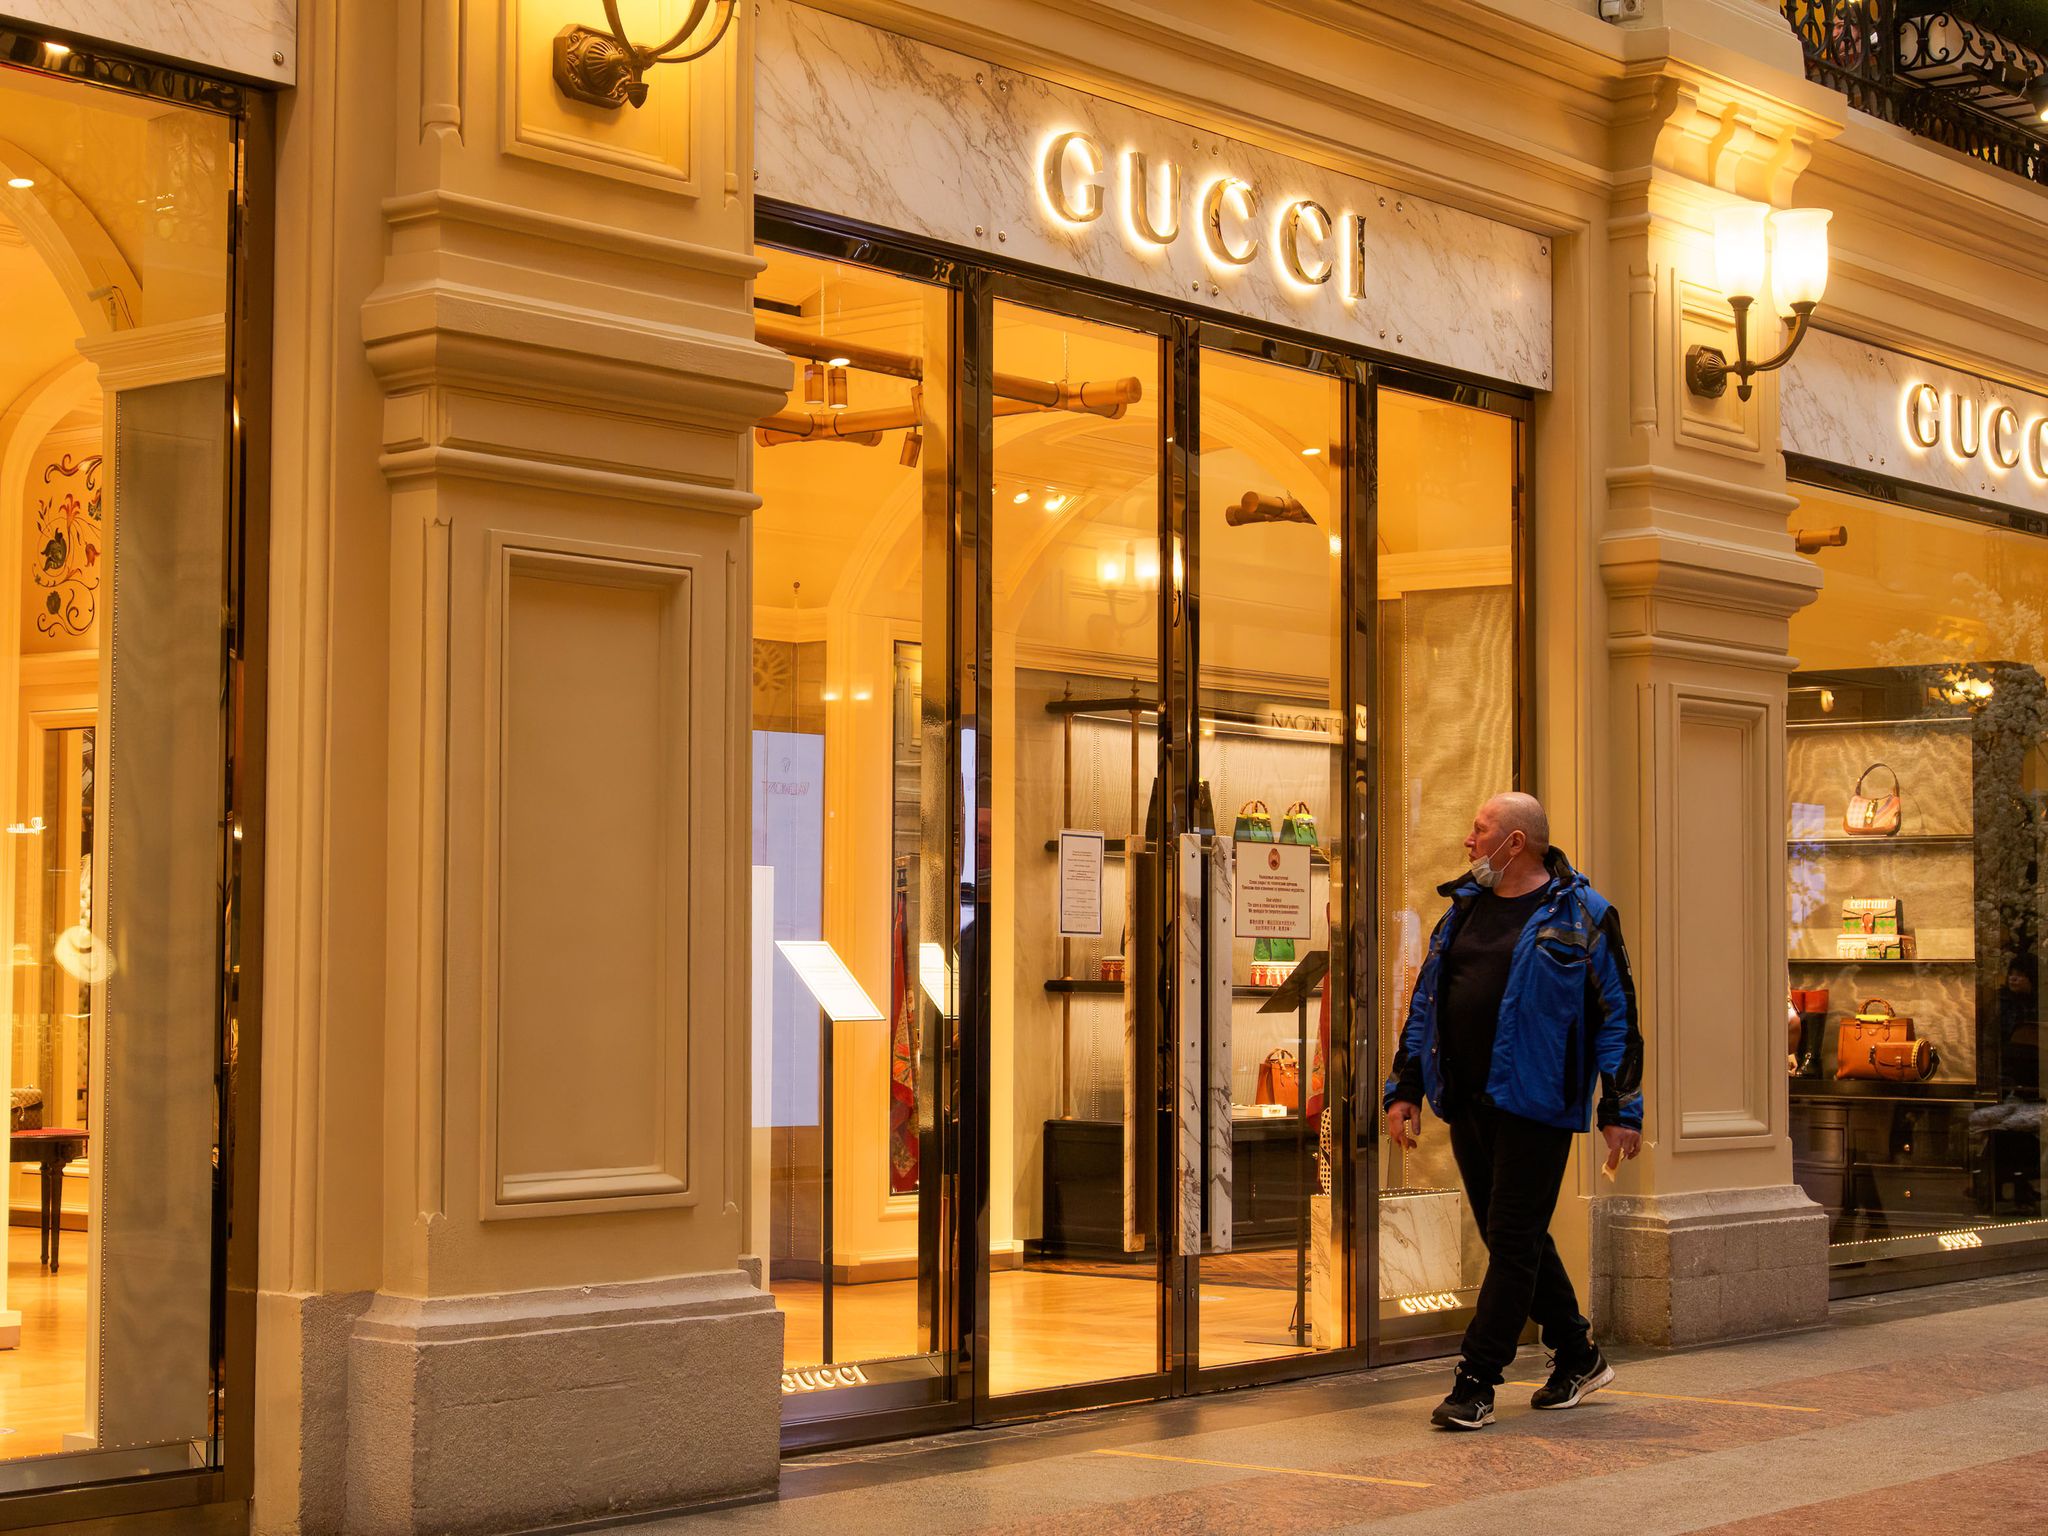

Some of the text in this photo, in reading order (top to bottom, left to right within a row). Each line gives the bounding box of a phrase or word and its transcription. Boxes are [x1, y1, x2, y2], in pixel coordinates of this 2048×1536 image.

[1043, 131, 1367, 300] GUCCI
[1938, 1231, 1982, 1248] GUCCI
[1400, 1292, 1462, 1313] GUCCI
